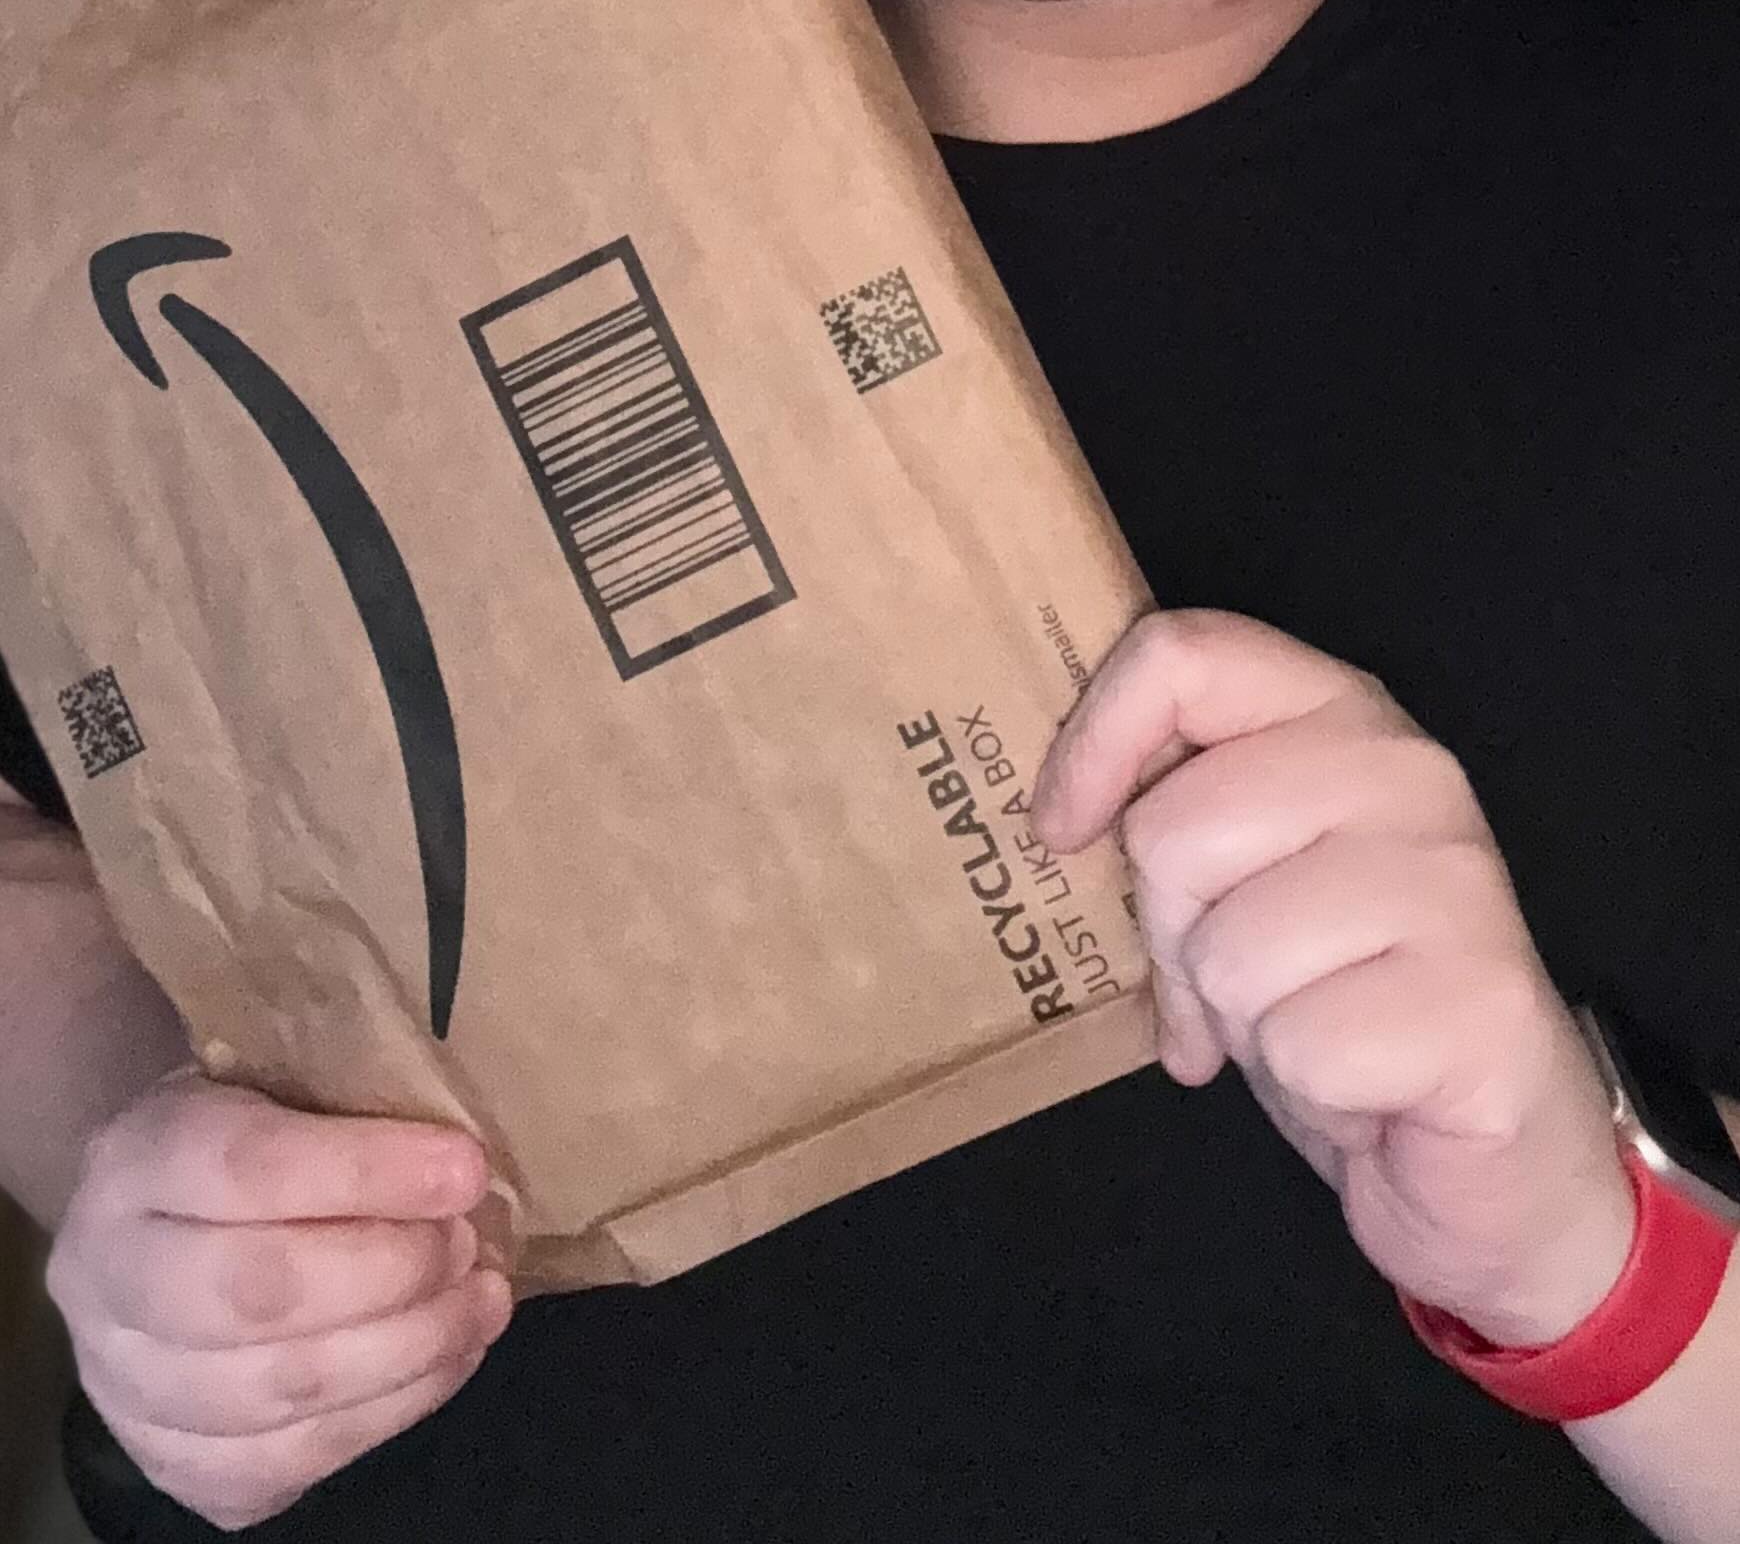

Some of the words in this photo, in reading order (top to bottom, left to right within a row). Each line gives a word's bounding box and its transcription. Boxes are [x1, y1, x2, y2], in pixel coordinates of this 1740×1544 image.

[957, 704, 1016, 788] BOX
[1001, 787, 1032, 816] A
[897, 709, 1074, 1024] RECYCLABLE
[1053, 915, 1120, 995] JUST
